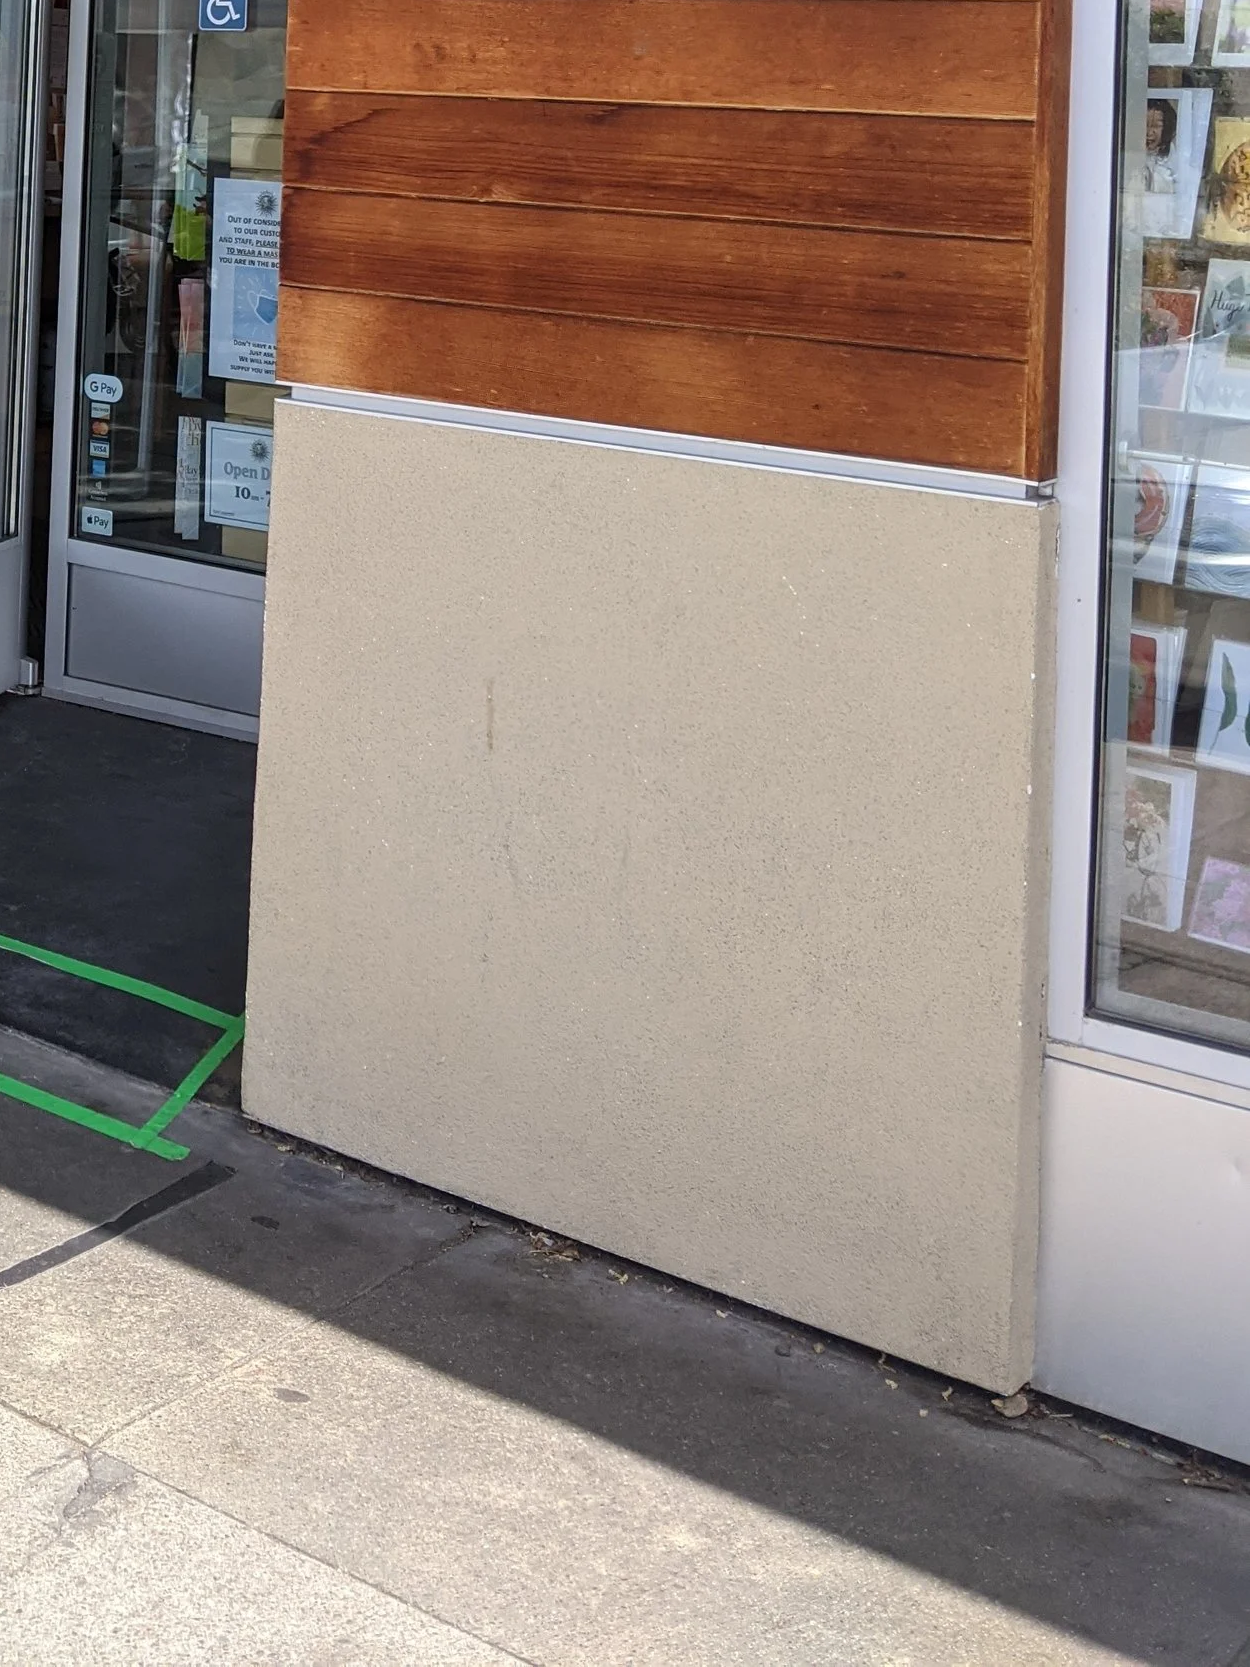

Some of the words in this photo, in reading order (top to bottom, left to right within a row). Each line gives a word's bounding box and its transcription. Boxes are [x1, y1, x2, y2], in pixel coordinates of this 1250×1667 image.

[253, 219, 280, 227] CONSIDE
[244, 228, 258, 236] OUR
[259, 230, 280, 238] CUSTO
[218, 236, 233, 244] AND
[234, 237, 254, 247] STAFF,
[255, 239, 278, 248] PLEASE
[237, 249, 255, 257] WEAR
[263, 251, 278, 259] MAS
[219, 256, 233, 264] YOU
[234, 258, 247, 266] ARE
[257, 260, 270, 268] THE
[249, 357, 262, 365] WILL
[89, 381, 99, 393] G
[100, 382, 117, 398] Pay
[93, 444, 108, 454] VISA
[223, 461, 258, 481] Open
[260, 467, 271, 481] D
[93, 515, 110, 529] Pay
